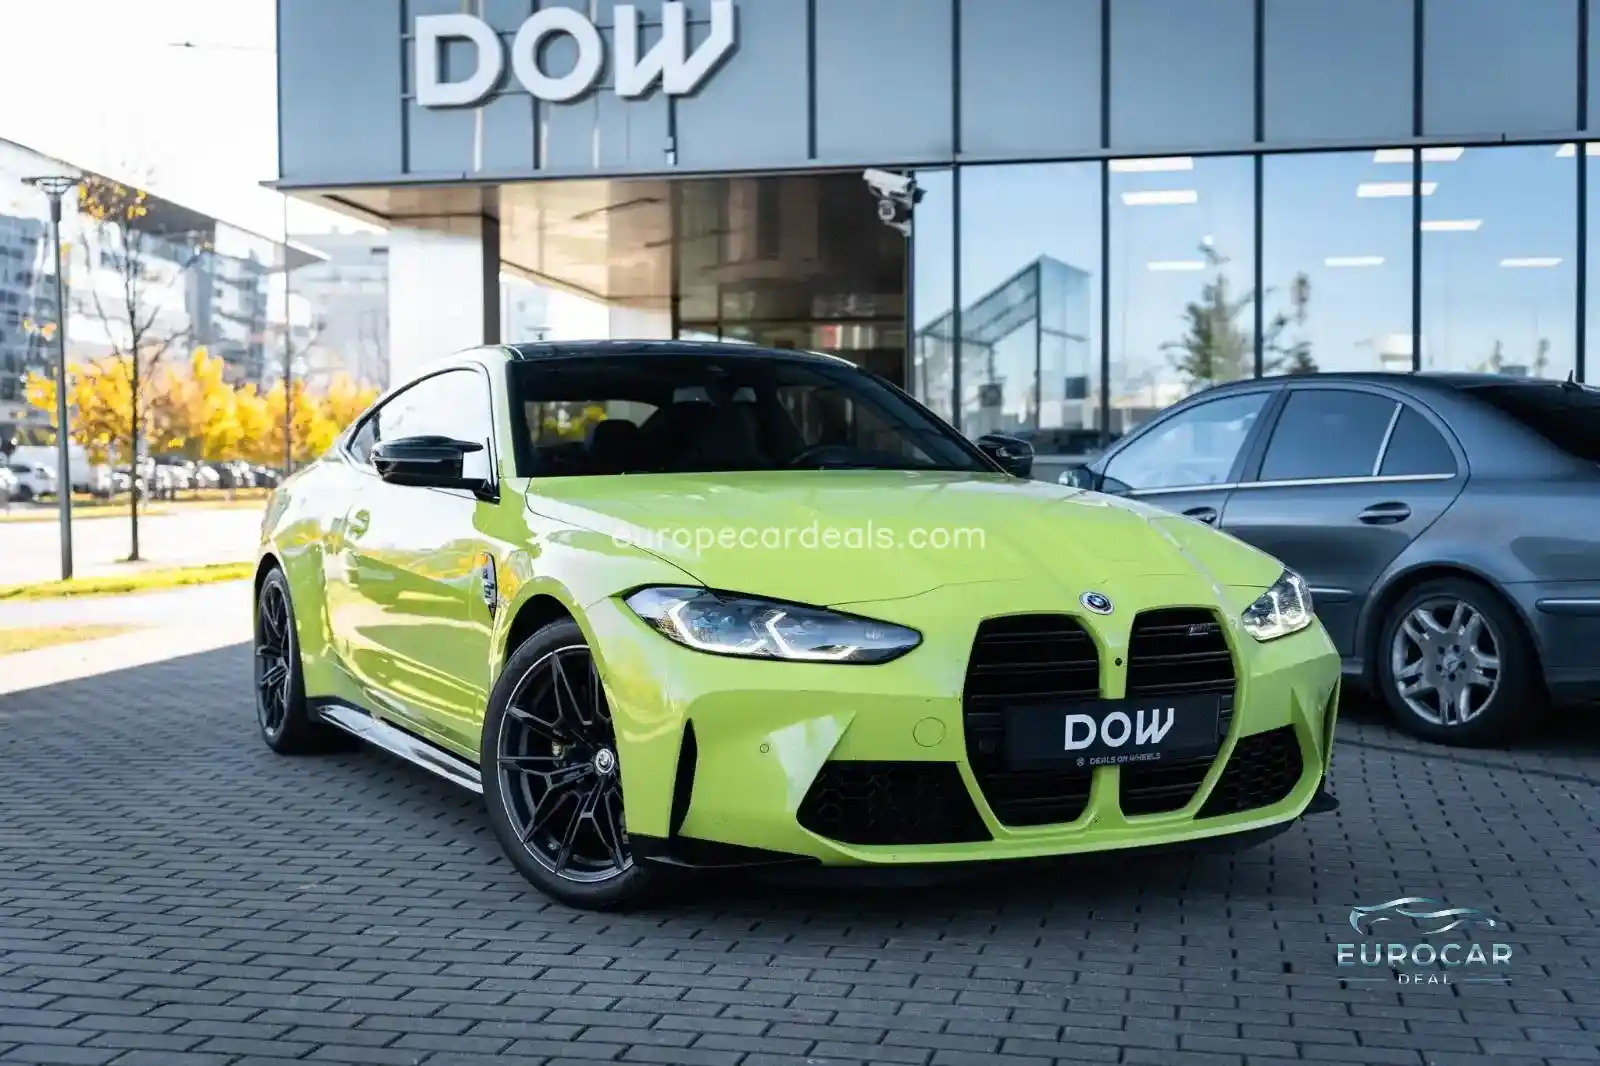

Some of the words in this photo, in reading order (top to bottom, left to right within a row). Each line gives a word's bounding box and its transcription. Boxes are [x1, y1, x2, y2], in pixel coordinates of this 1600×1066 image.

[415, 0, 735, 106] DOW
[1064, 708, 1175, 750] DOW
[1090, 756, 1116, 765] DEALS
[1117, 755, 1128, 763] ON
[1129, 752, 1161, 761] WHEELS
